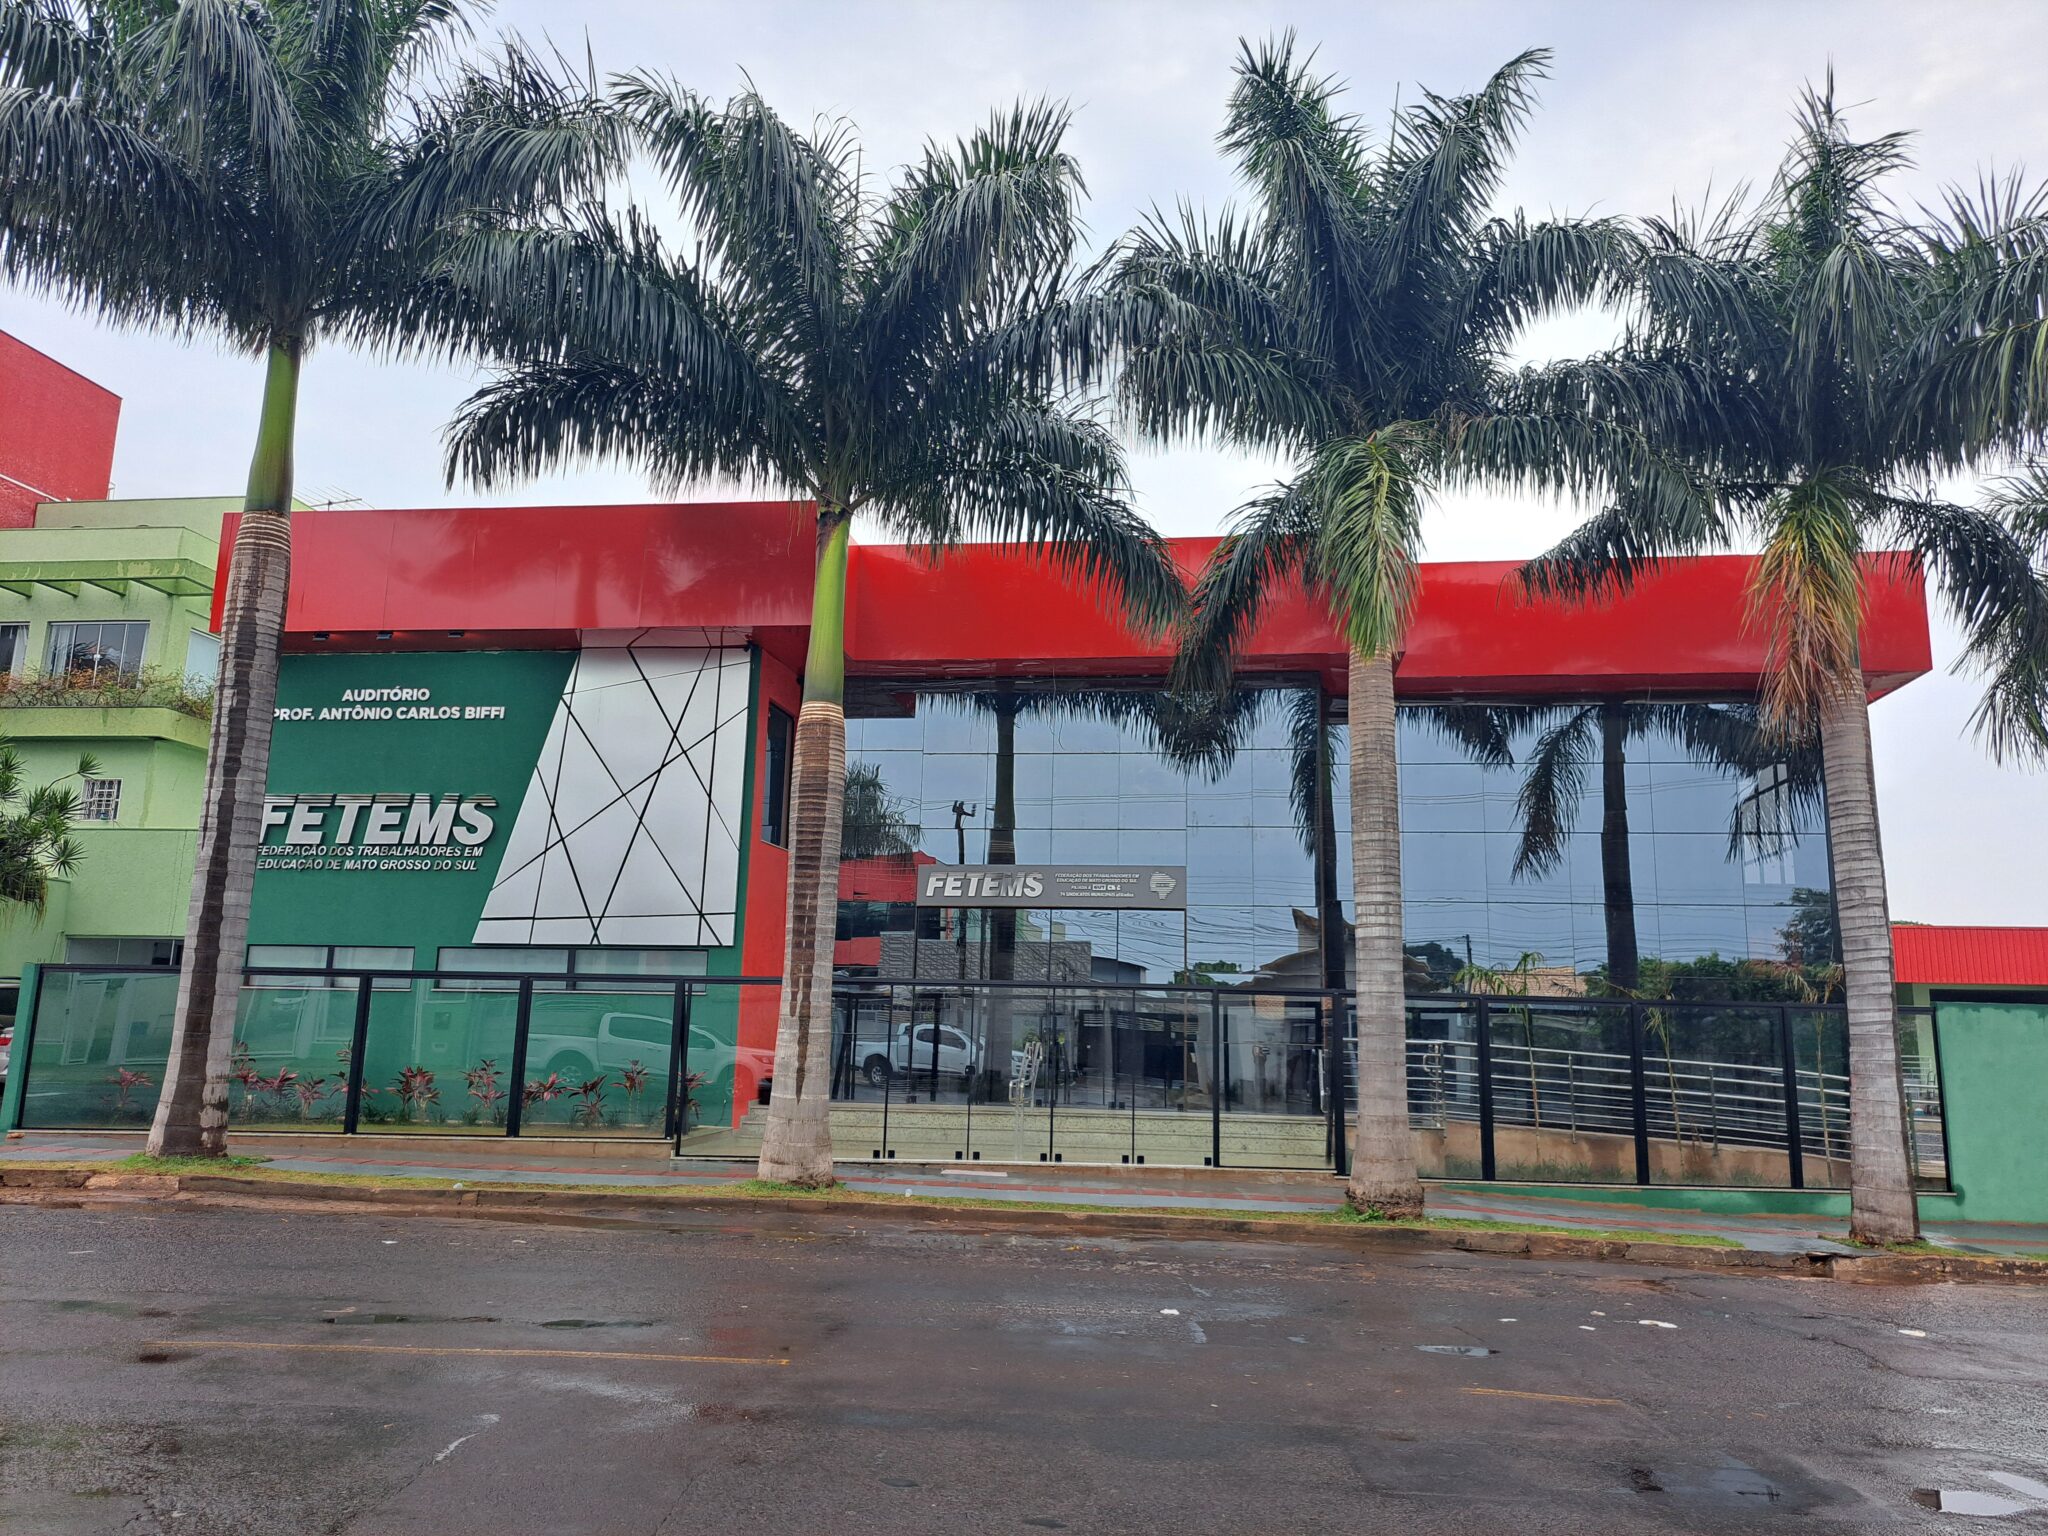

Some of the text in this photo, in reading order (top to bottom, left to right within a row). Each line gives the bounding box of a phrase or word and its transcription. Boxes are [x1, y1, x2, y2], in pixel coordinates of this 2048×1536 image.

[341, 686, 431, 702] AUDITÓRIO
[273, 704, 505, 720] PROF. ANTÔNIO CARLOS BIFFI
[258, 793, 498, 846] FETEMS
[329, 846, 355, 857] DOS
[357, 846, 462, 857] TRABALHADORES
[463, 846, 484, 857] EM
[256, 858, 478, 871] EDUCAÇÃO DE MATO GROSSO DO SUL
[925, 871, 1044, 897] FETEMS
